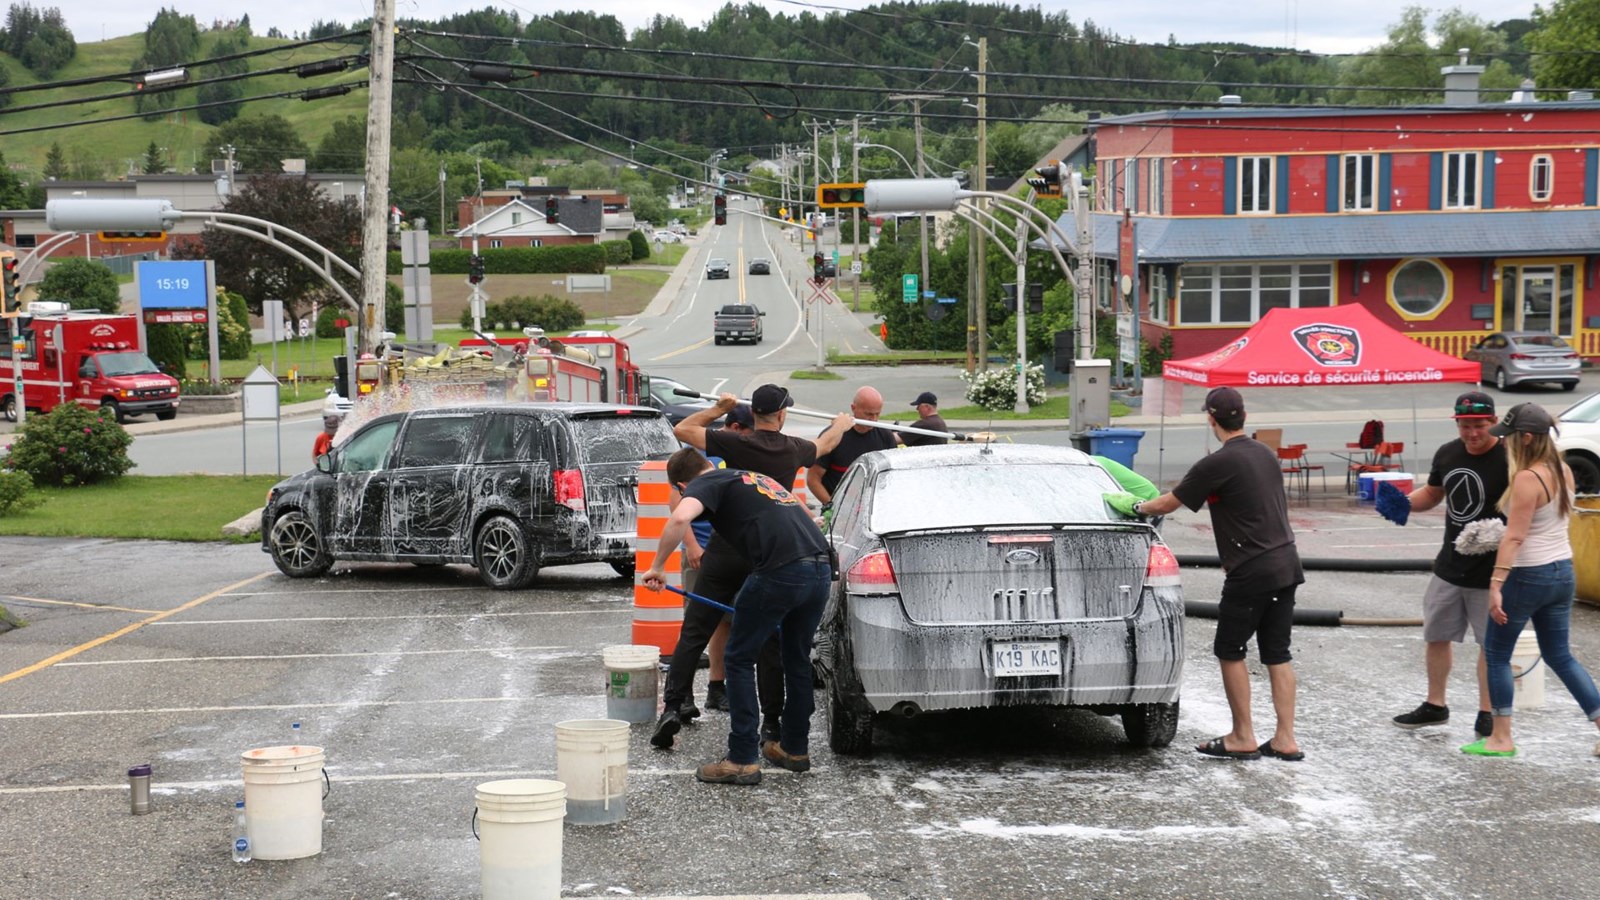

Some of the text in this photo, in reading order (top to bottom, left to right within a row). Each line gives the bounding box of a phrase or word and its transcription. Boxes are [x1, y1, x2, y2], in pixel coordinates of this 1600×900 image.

[852, 265, 862, 274] 50
[156, 278, 189, 290] 15:19
[1247, 367, 1442, 385] Service de sécurité incendie
[996, 649, 1058, 669] K19 KAC
